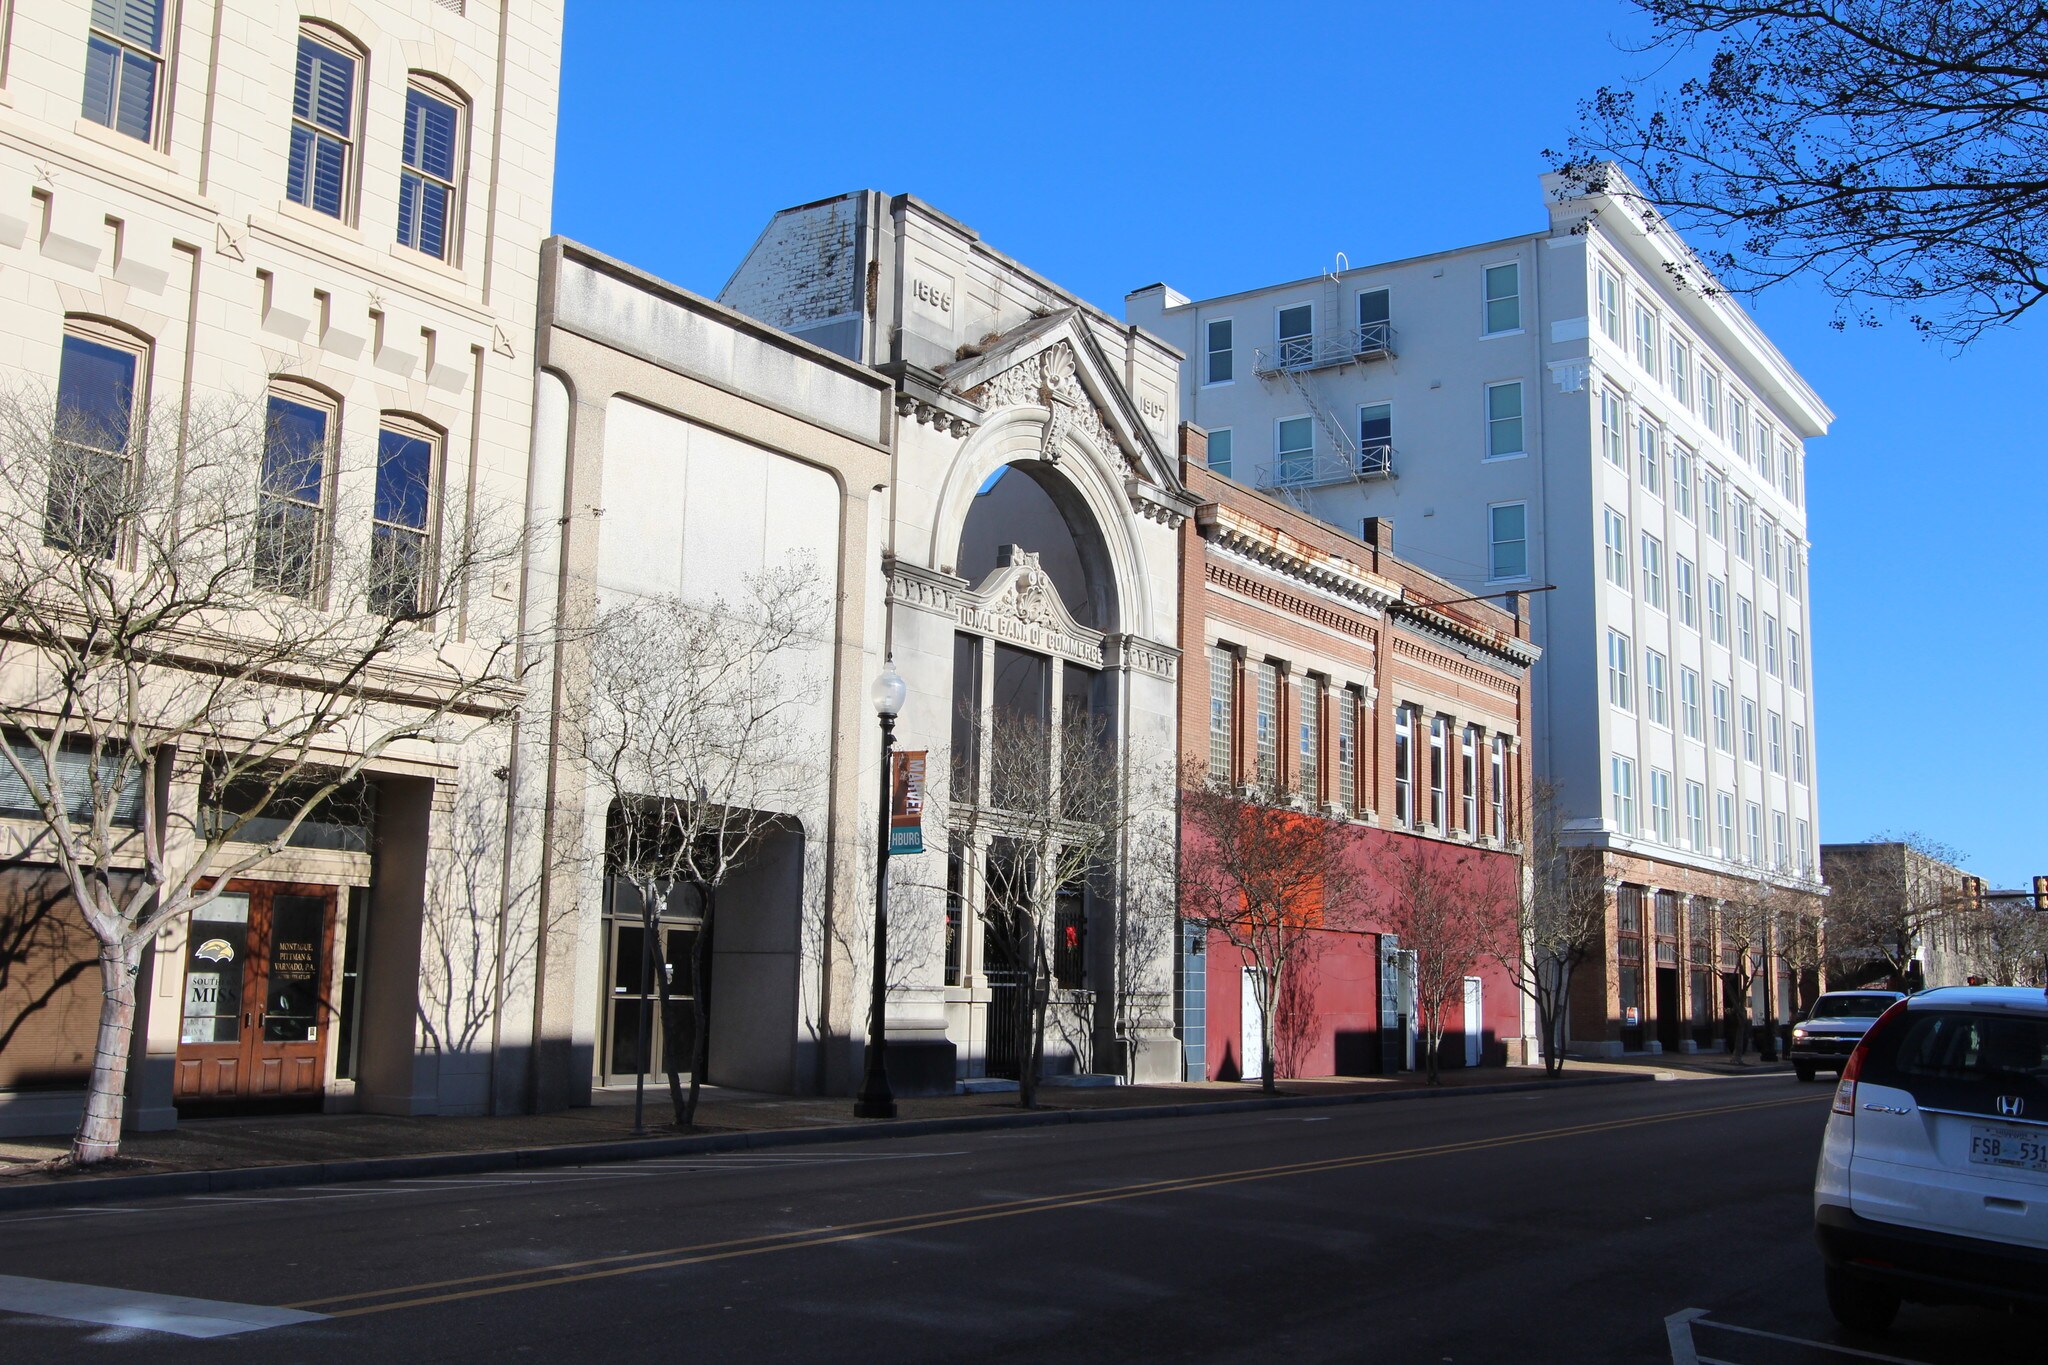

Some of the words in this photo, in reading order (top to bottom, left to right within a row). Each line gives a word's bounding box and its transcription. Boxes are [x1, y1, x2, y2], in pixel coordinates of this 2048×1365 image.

[1140, 396, 1165, 421] 1907
[997, 618, 1028, 642] BANK
[1030, 628, 1043, 646] OF
[1046, 634, 1104, 664] COMMERCE
[906, 759, 925, 816] MARVEL
[891, 831, 920, 846] HBURG
[279, 952, 305, 961] PITTMAN
[306, 953, 312, 961] &
[191, 987, 236, 1003] MISS
[1972, 1136, 2001, 1157] FSB
